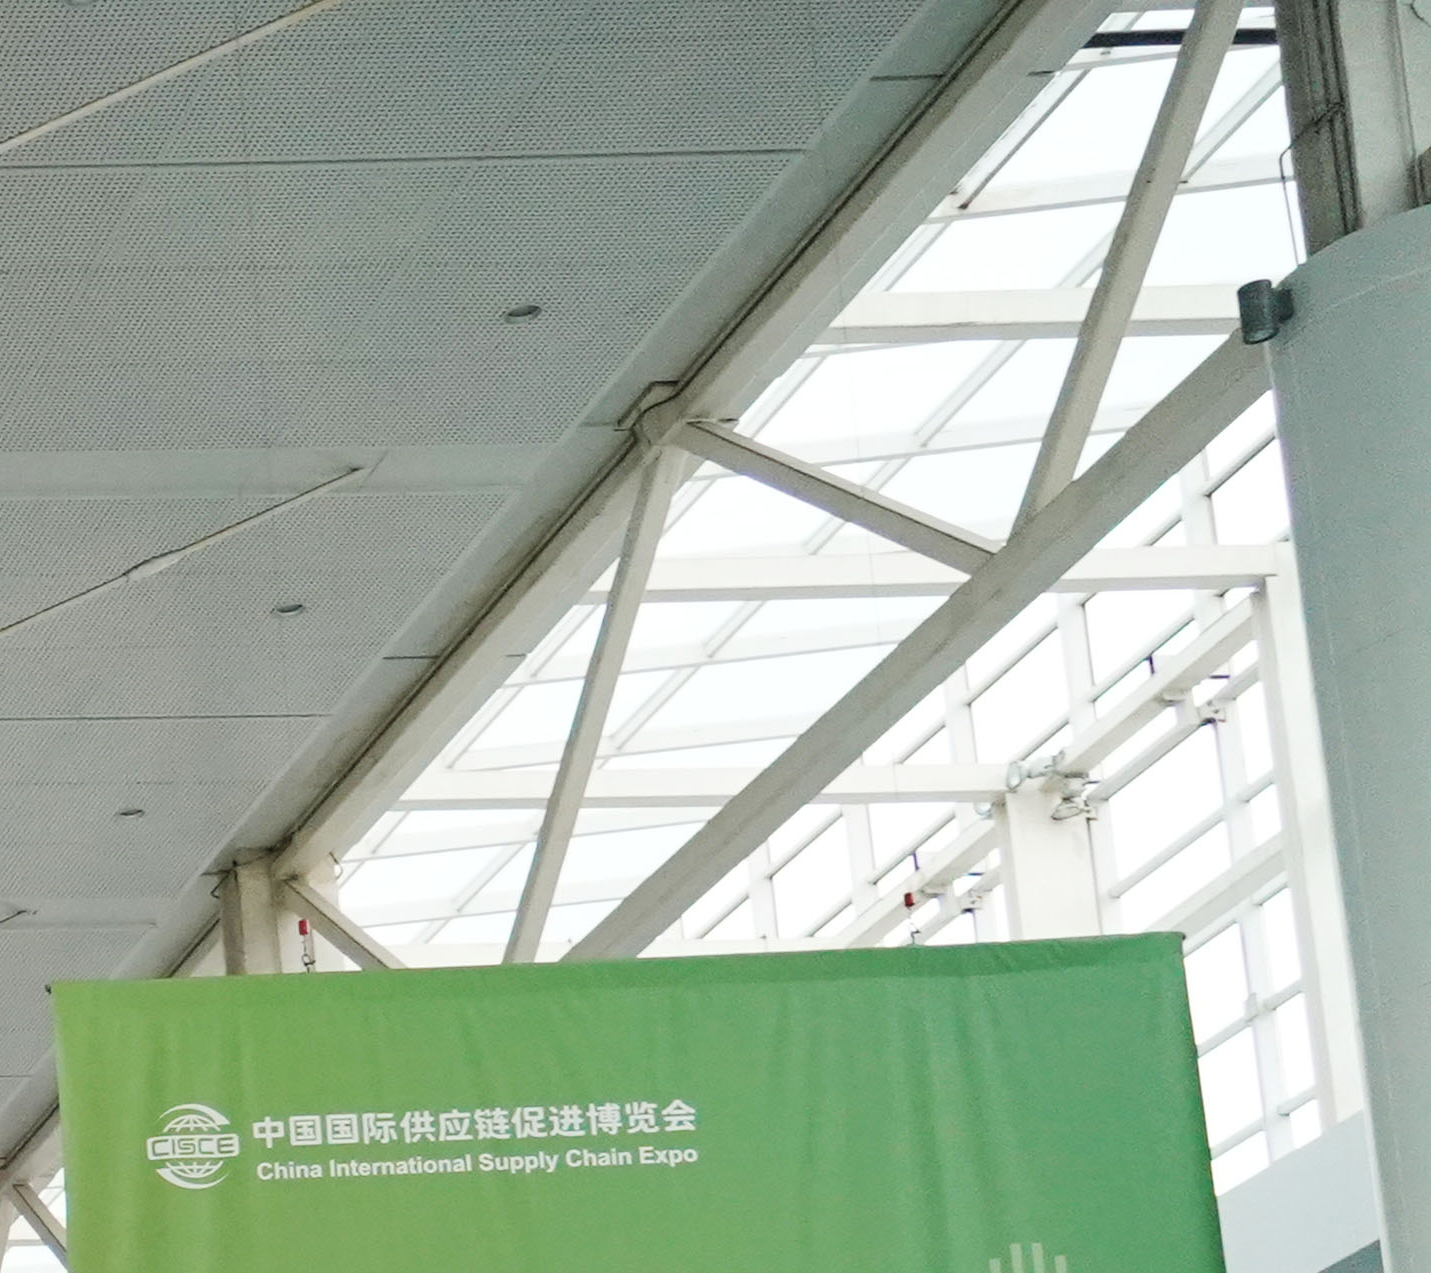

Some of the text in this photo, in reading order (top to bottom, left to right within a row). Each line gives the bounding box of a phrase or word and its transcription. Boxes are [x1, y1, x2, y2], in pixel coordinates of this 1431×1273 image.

[253, 1099, 696, 1148] 中国国际供应链促进博览会
[257, 1146, 698, 1180] China International Supply Chain Expo
